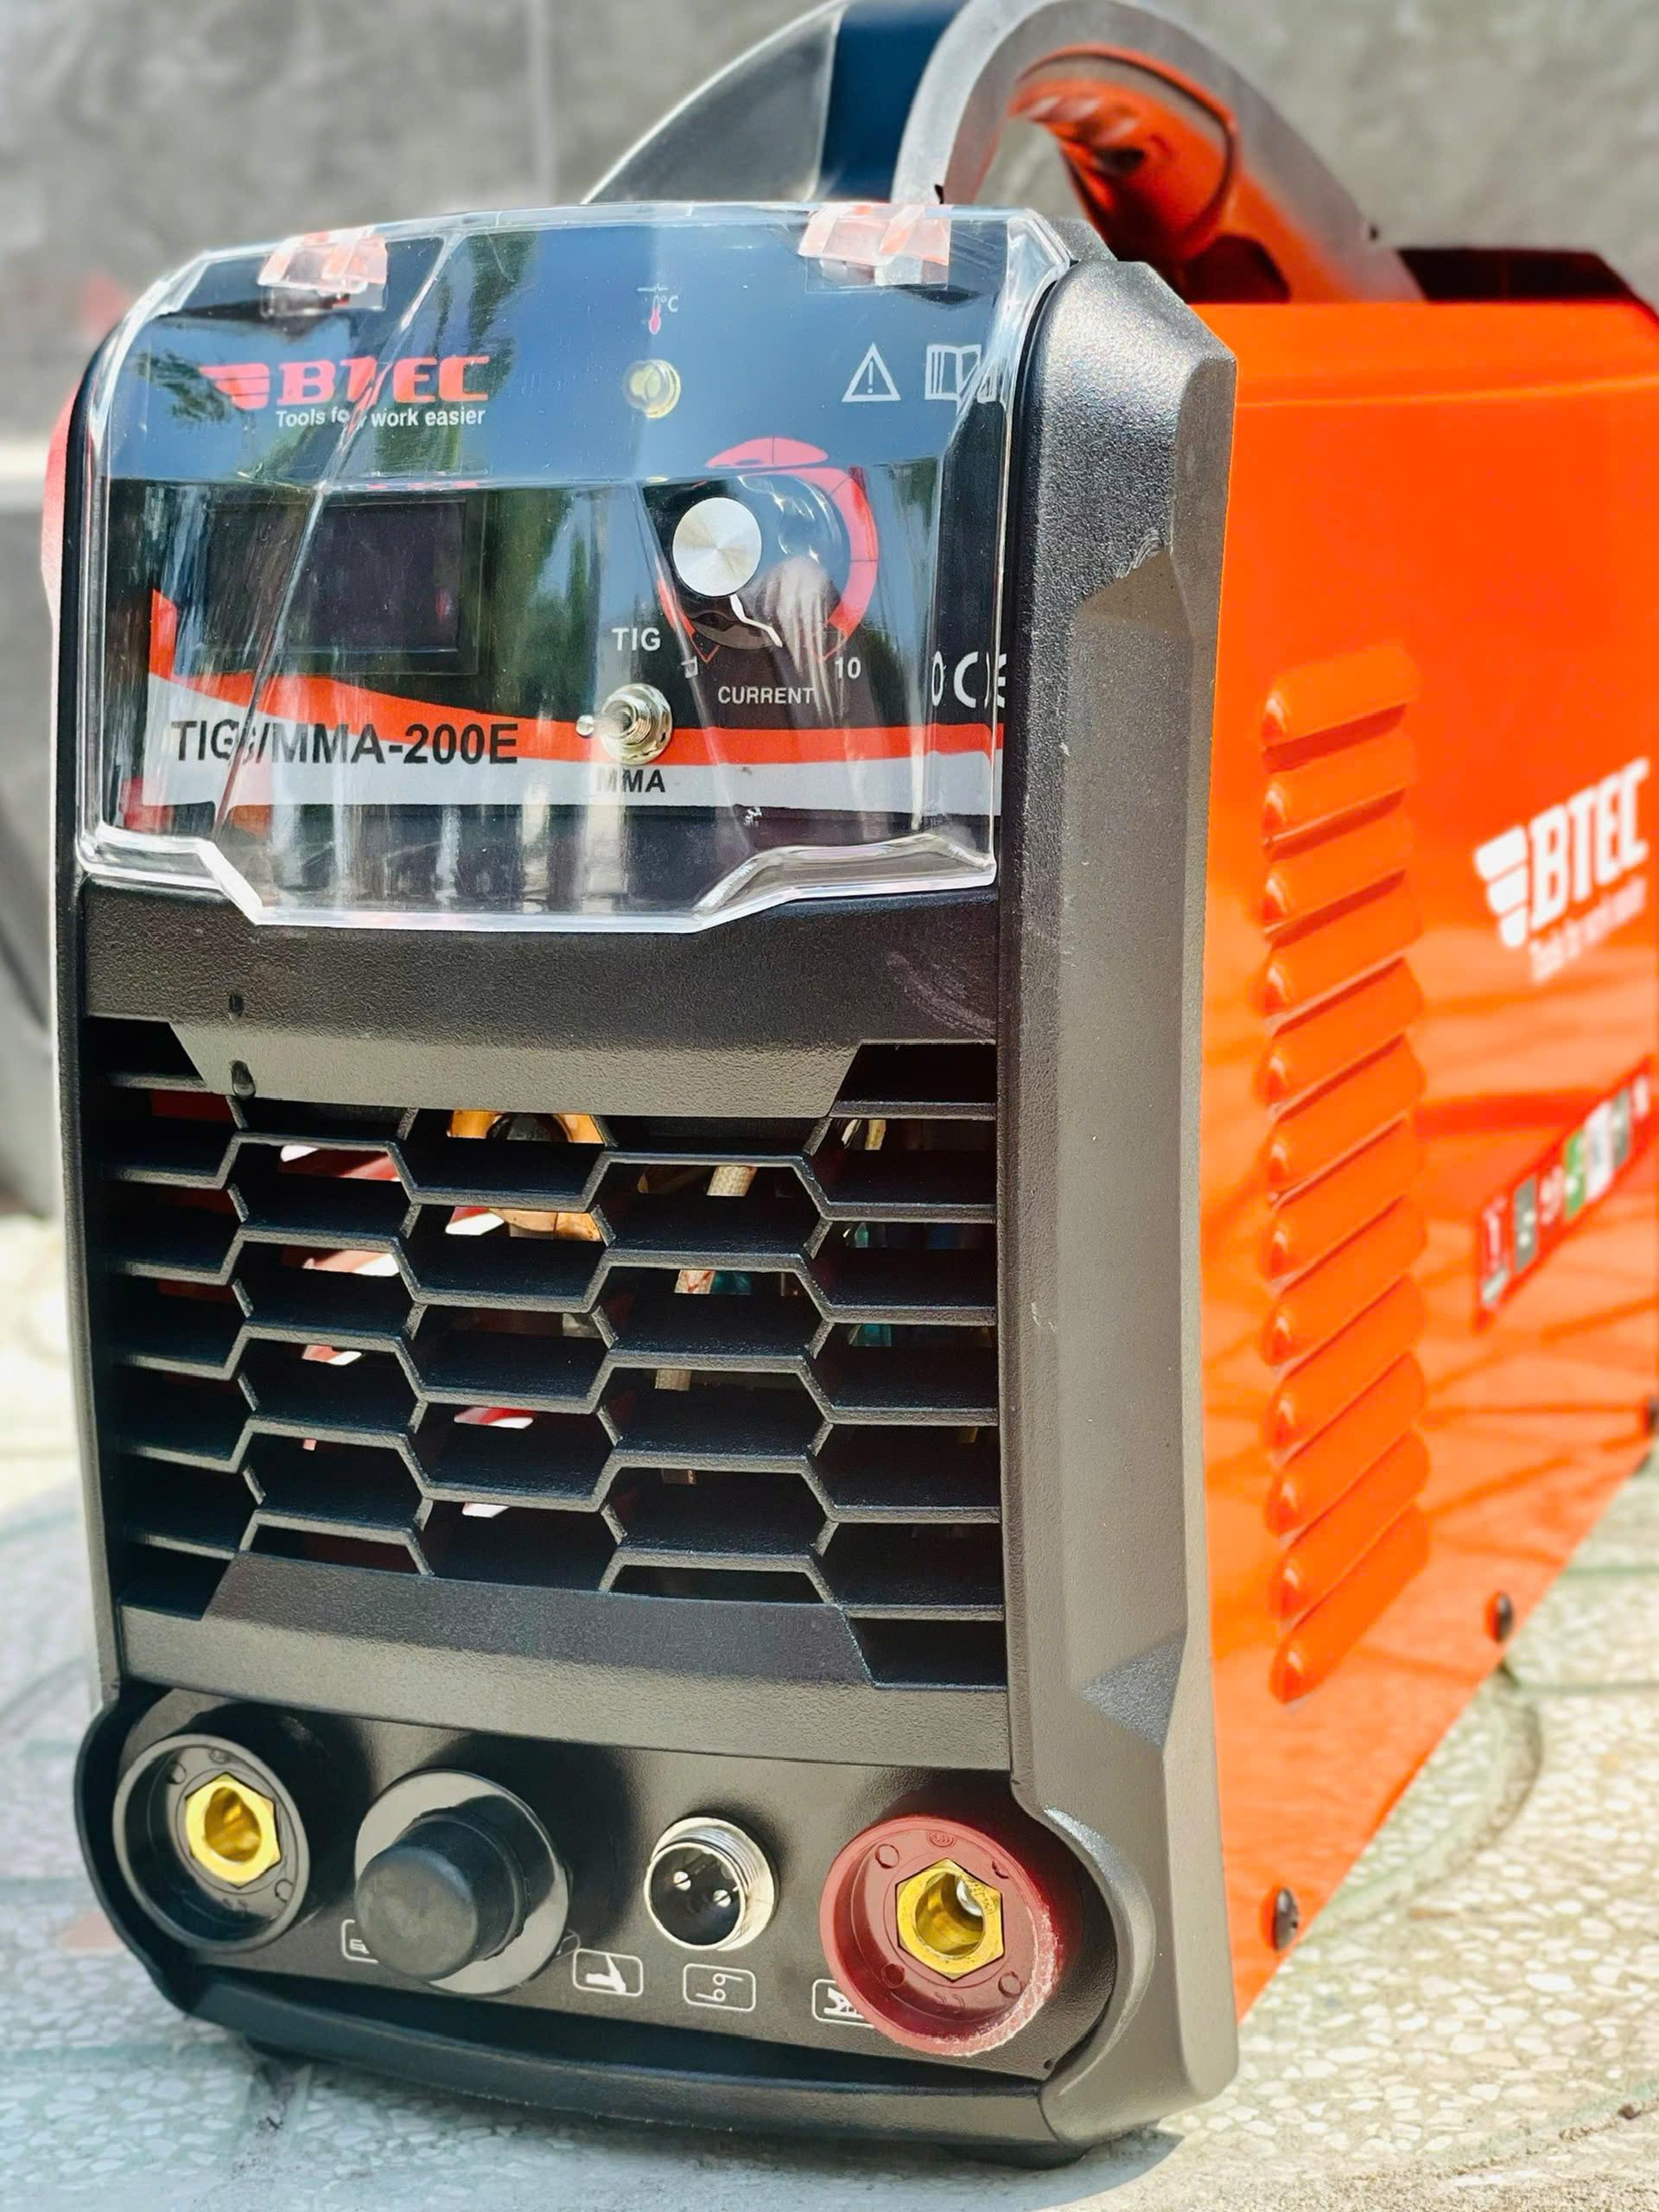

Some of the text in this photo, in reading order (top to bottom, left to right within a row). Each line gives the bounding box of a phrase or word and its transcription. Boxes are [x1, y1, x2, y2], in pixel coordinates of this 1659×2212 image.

[276, 355, 489, 406] BTEC
[276, 410, 326, 427] Tools
[371, 407, 418, 428] work
[424, 409, 486, 426] easier
[611, 627, 662, 652] TIG
[834, 657, 861, 679] 10
[717, 685, 815, 705] CURRENT
[595, 768, 666, 793] MMA
[1529, 756, 1649, 932] BTEC
